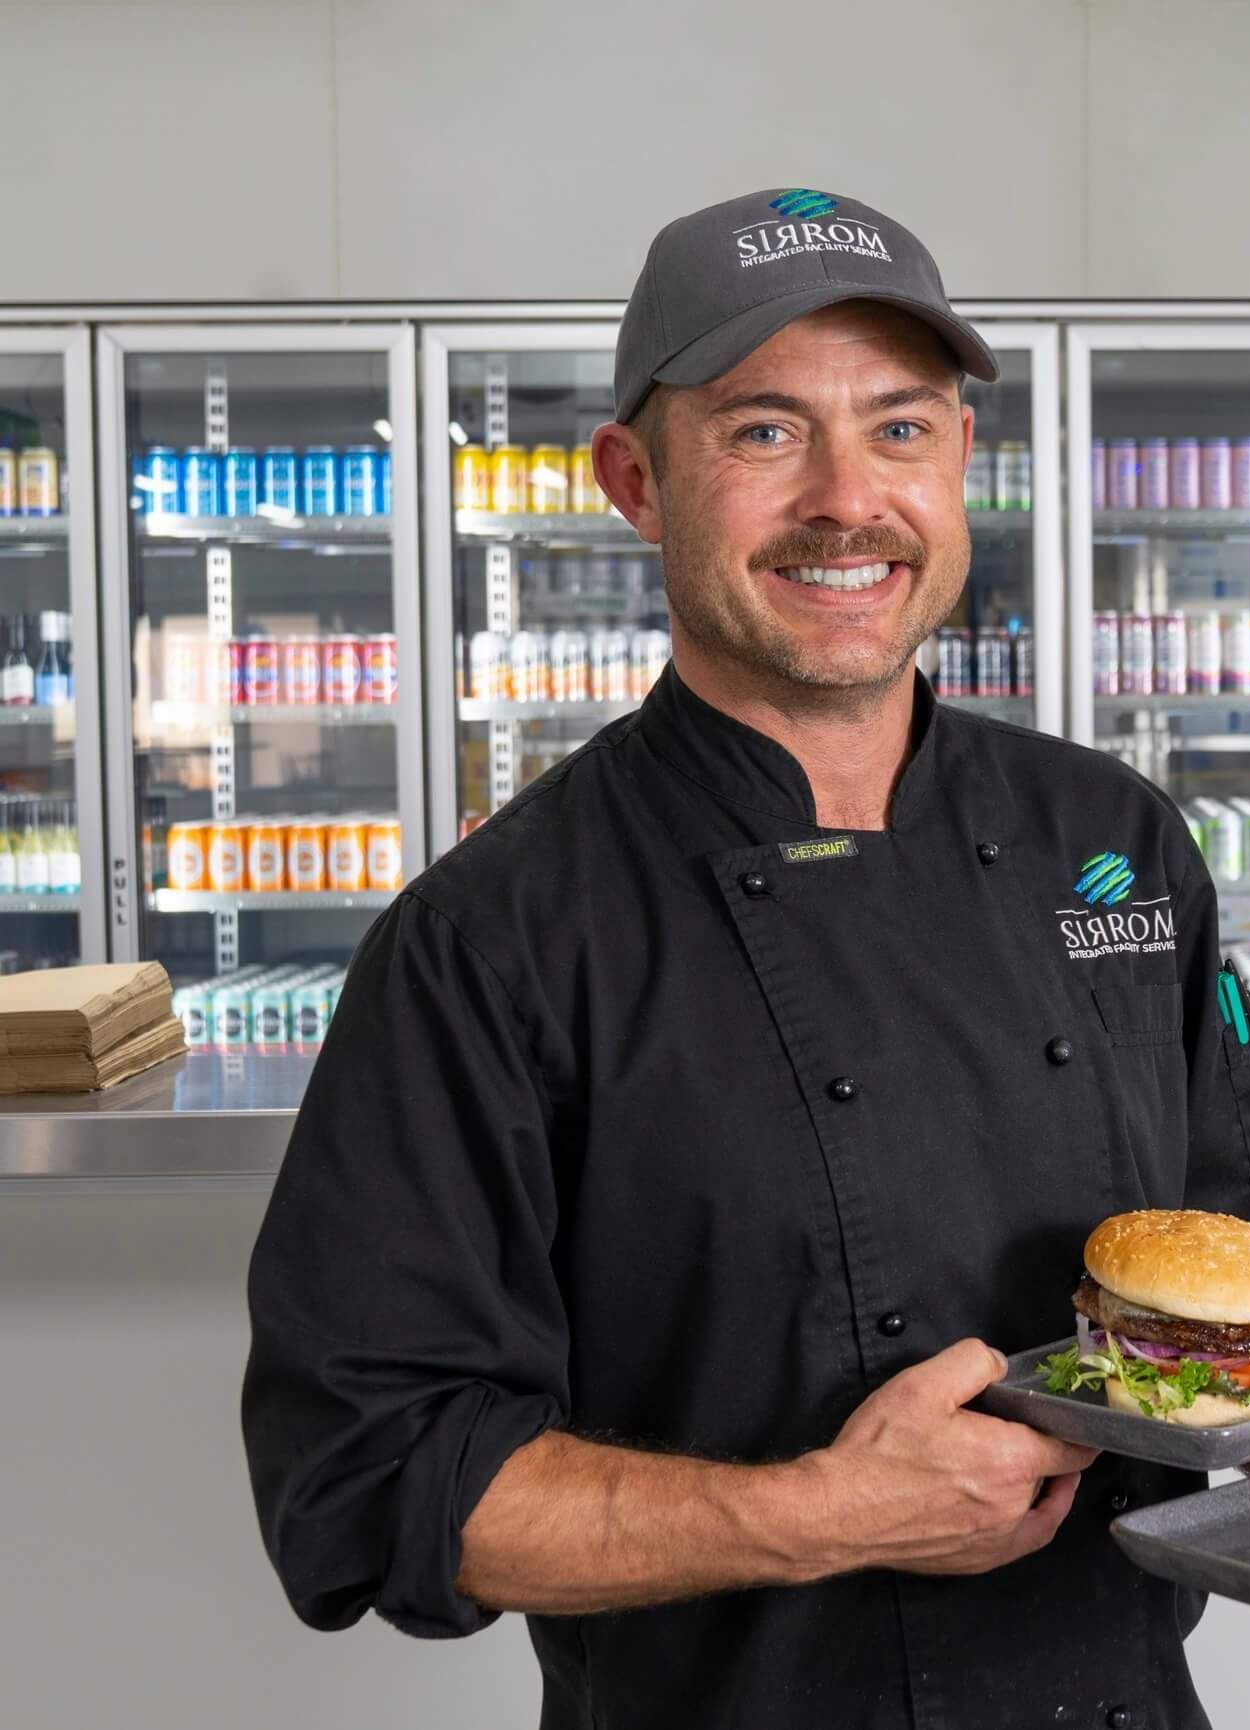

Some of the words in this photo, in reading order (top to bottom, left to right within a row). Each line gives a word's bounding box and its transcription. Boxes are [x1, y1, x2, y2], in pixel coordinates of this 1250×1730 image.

[740, 245, 804, 268] INTEGRATED
[804, 242, 851, 253] FACILITY
[850, 244, 893, 263] SERVICES
[787, 841, 846, 860] CHEFSCRAFT
[114, 858, 127, 926] PULL
